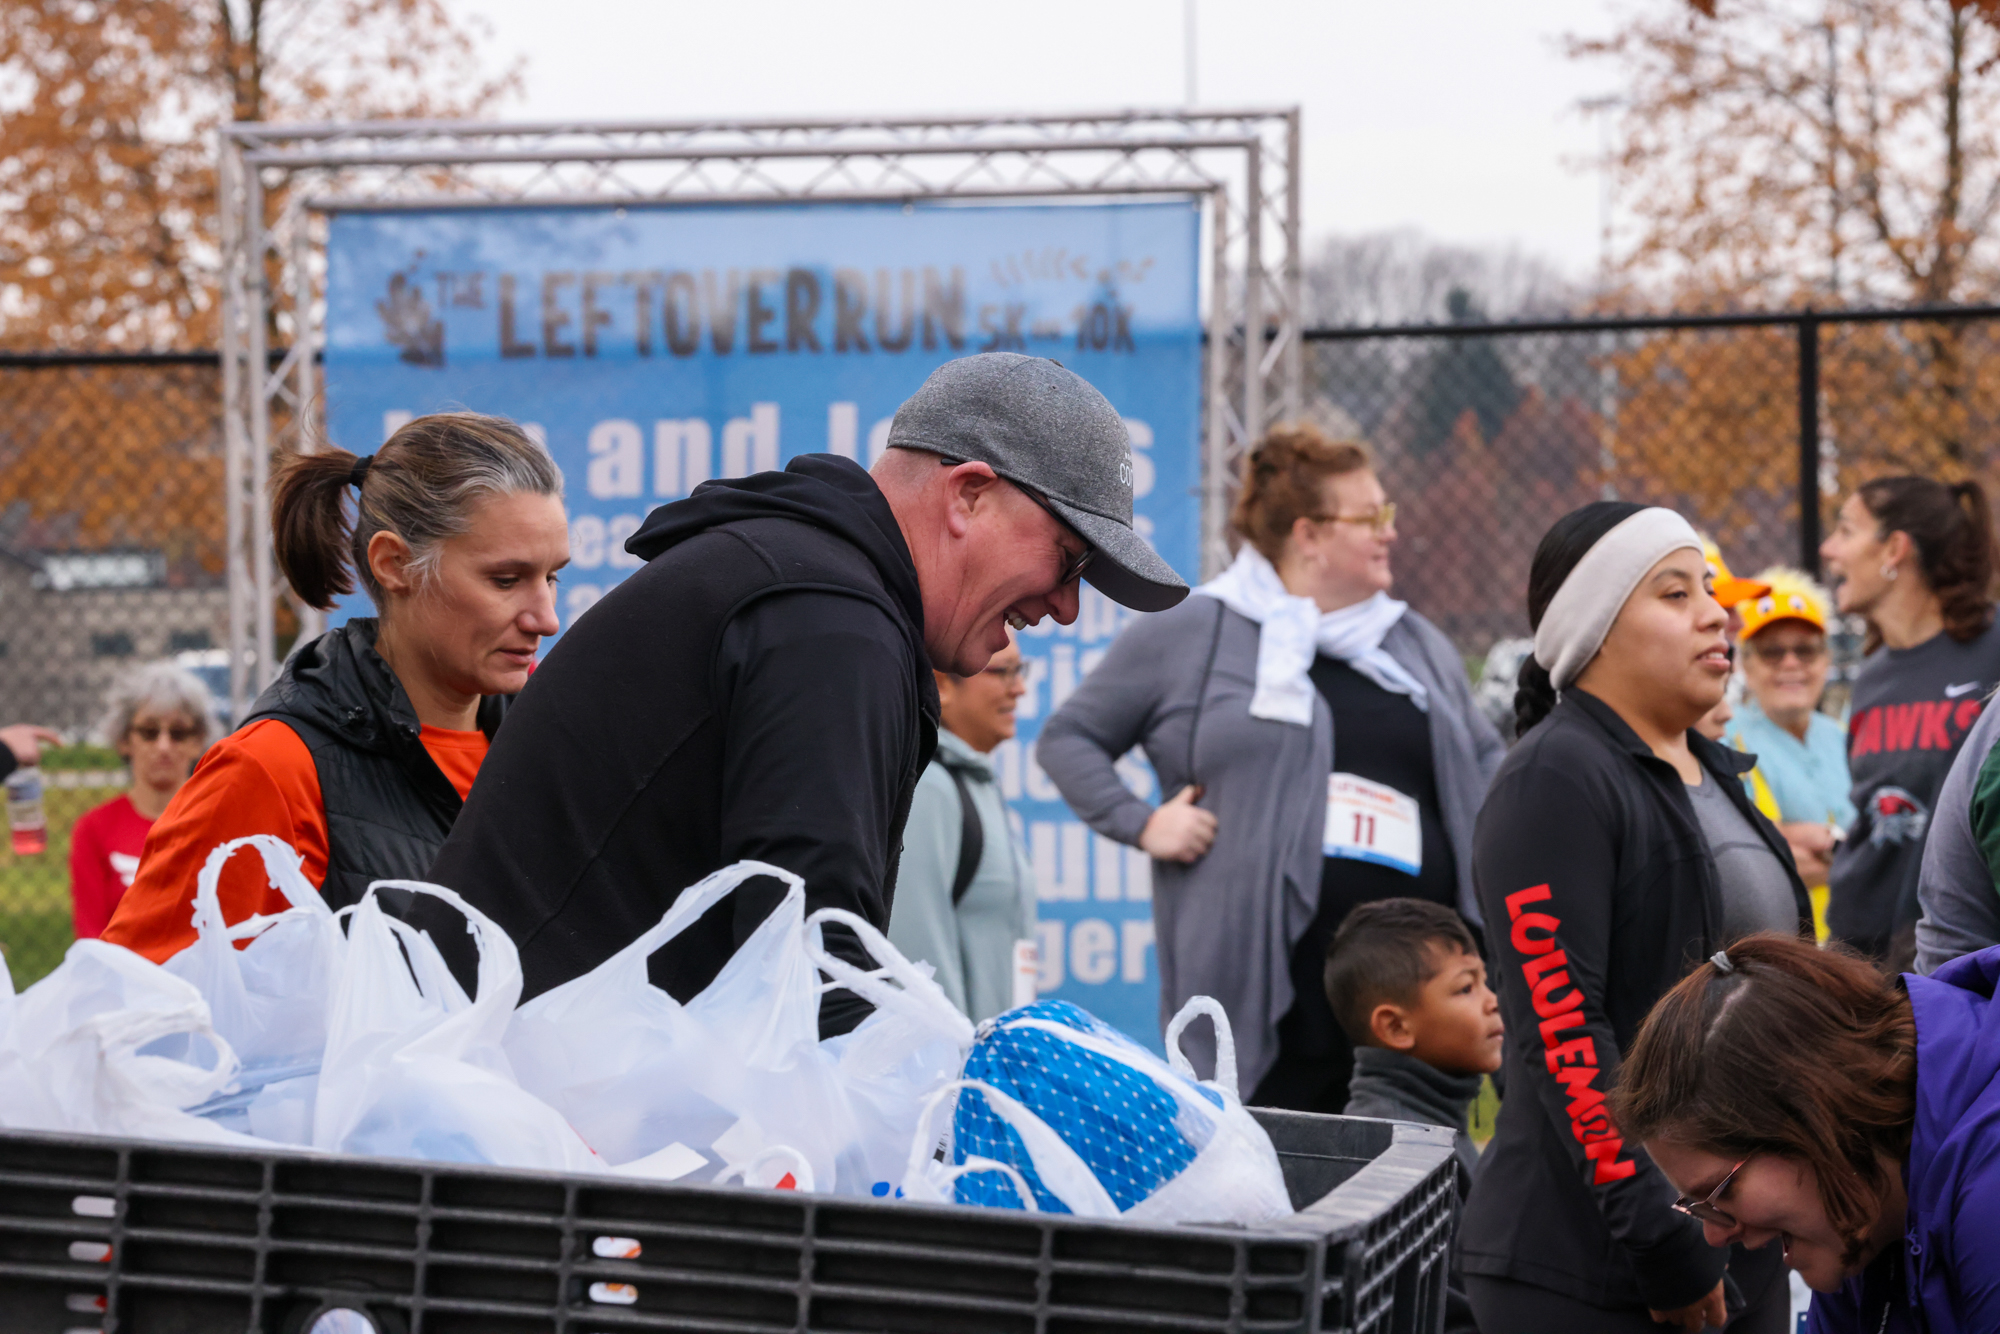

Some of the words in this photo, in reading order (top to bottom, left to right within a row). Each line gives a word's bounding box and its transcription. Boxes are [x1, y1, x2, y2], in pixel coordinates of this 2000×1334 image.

[498, 267, 823, 358] LEFTOVER
[834, 266, 968, 355] RUN
[587, 402, 780, 498] and
[1352, 812, 1376, 847] 11
